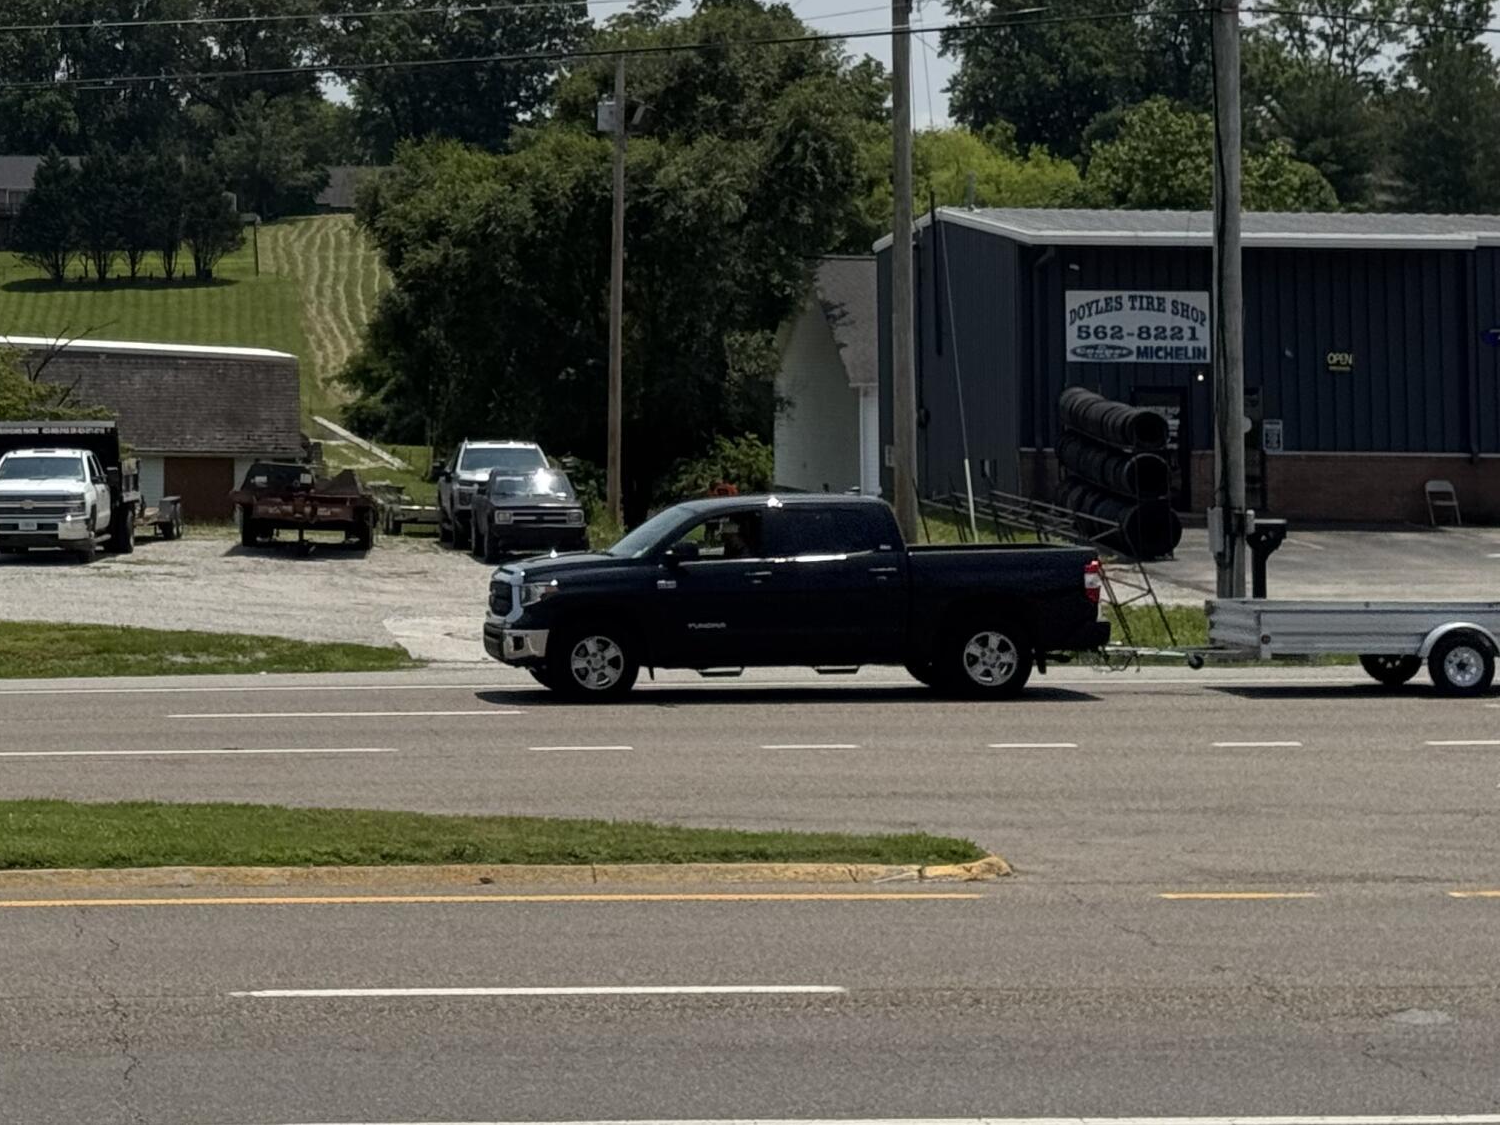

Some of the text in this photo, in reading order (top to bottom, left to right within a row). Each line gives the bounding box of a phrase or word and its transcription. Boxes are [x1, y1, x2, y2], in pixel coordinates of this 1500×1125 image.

[1069, 294, 1207, 327] DOYLES TIRE SHOP
[1076, 325, 1199, 341] 562-8221
[1136, 345, 1207, 361] MICHELIN
[1327, 352, 1353, 365] OPEN
